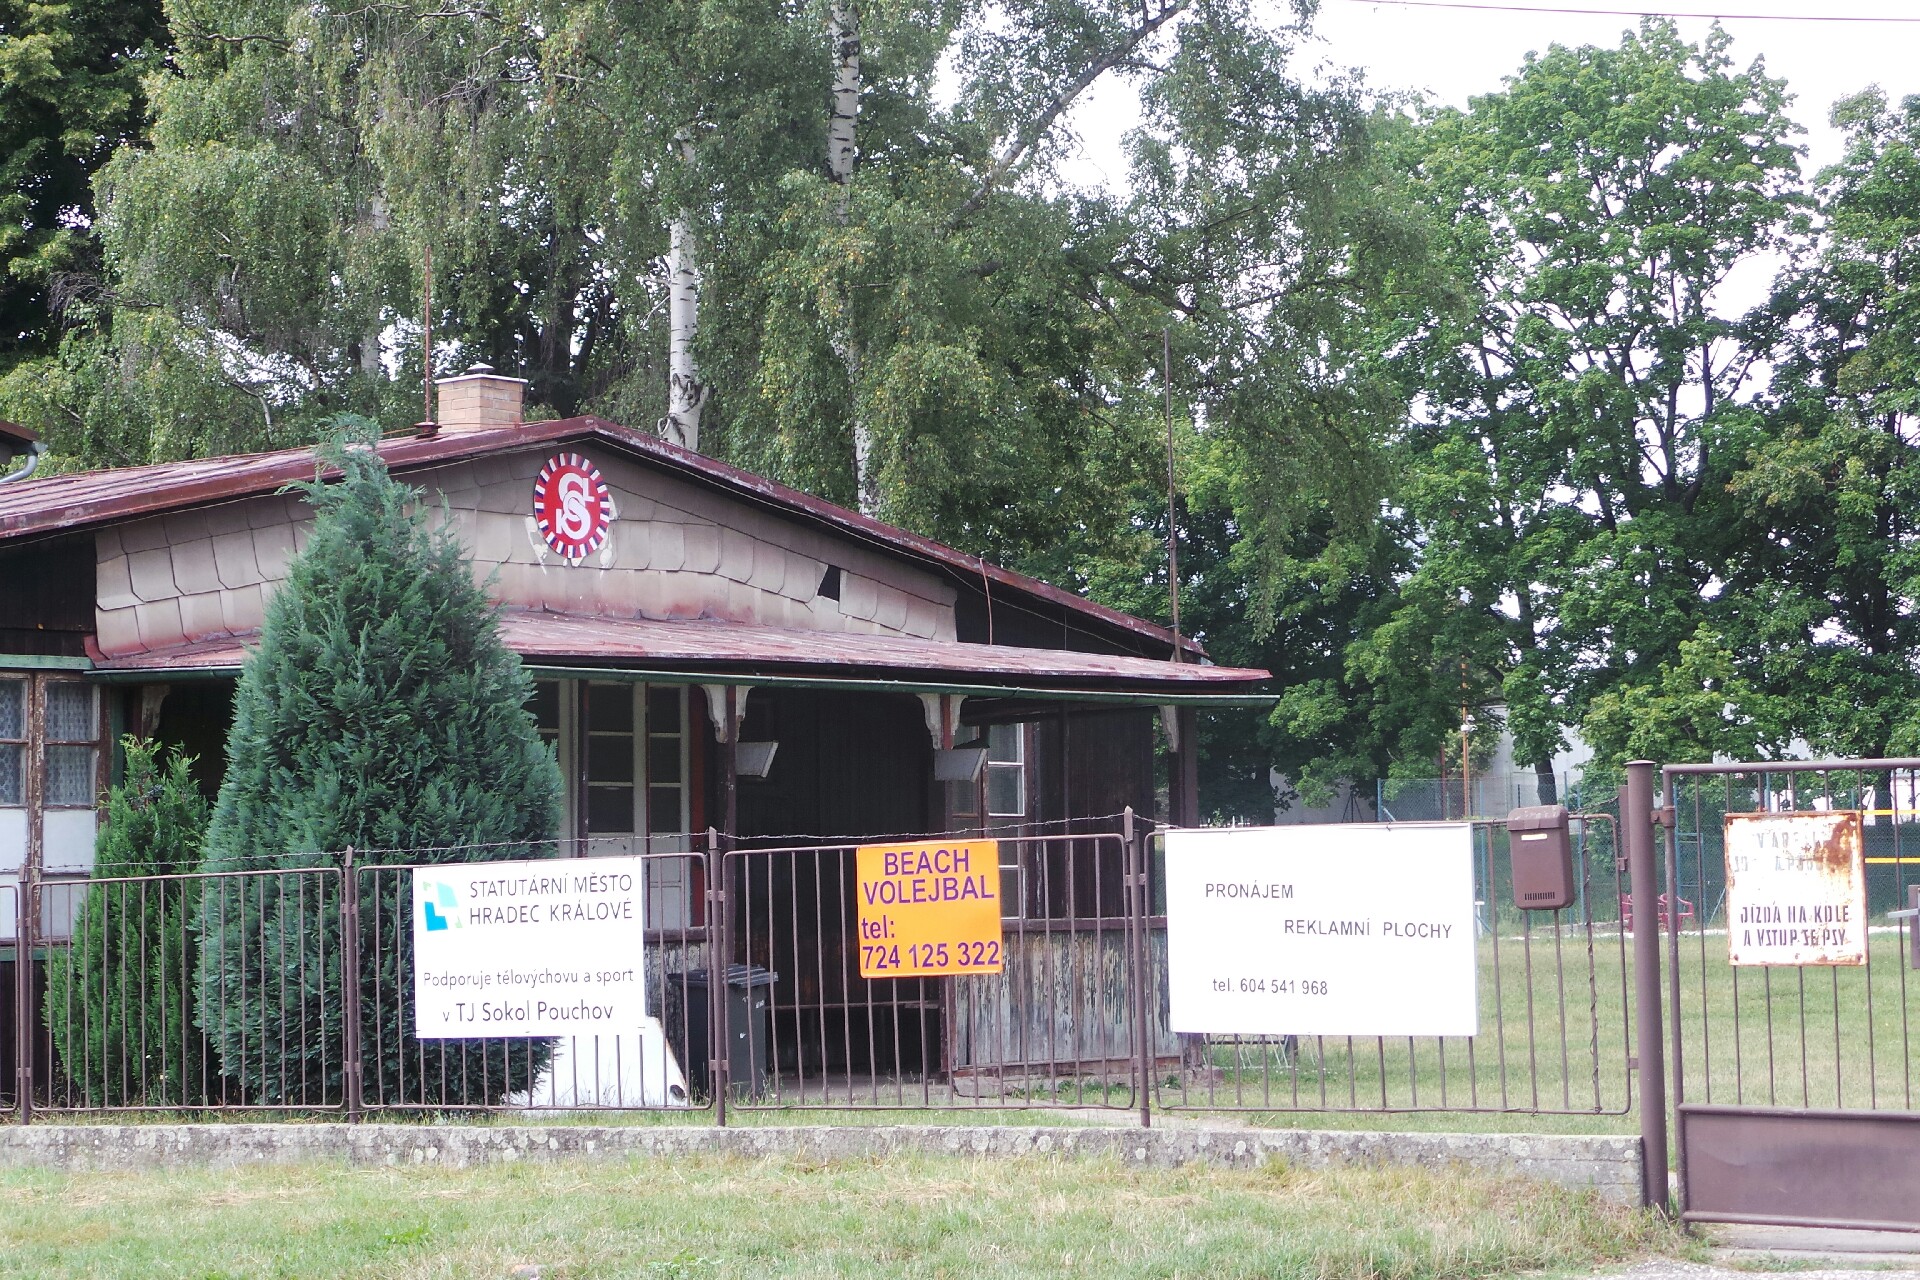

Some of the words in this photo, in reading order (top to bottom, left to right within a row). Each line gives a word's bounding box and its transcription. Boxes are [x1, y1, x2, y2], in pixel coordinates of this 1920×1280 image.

[885, 849, 968, 875] BEACH
[470, 872, 569, 899] STATUTÁRNÍ
[574, 872, 632, 894] MĚSTO
[864, 875, 994, 904] VOLEJBAL
[1205, 879, 1294, 899] PRONÁJEM
[469, 904, 540, 925] HRADEC
[550, 897, 633, 922] KRÁLOVÉ
[862, 915, 894, 939] tel:
[1284, 917, 1370, 936] REKLAMNÍ
[1383, 921, 1452, 939] PLOCHY
[1743, 929, 1752, 947] A
[1756, 928, 1798, 947] VSTUP
[1823, 928, 1847, 946] PSY
[863, 945, 900, 969] 724
[909, 943, 948, 968] 125
[958, 941, 999, 966] 322
[424, 970, 491, 991] Podporuje
[583, 972, 591, 983] a
[596, 968, 634, 987] sport
[1212, 977, 1235, 992] tel.
[1240, 977, 1266, 993] 604
[1271, 979, 1295, 994] 541
[1301, 979, 1328, 996] 968
[442, 1011, 450, 1023] v
[455, 1002, 475, 1022] TJ
[482, 1000, 530, 1022] Sokol
[537, 998, 614, 1021] Pouchov
